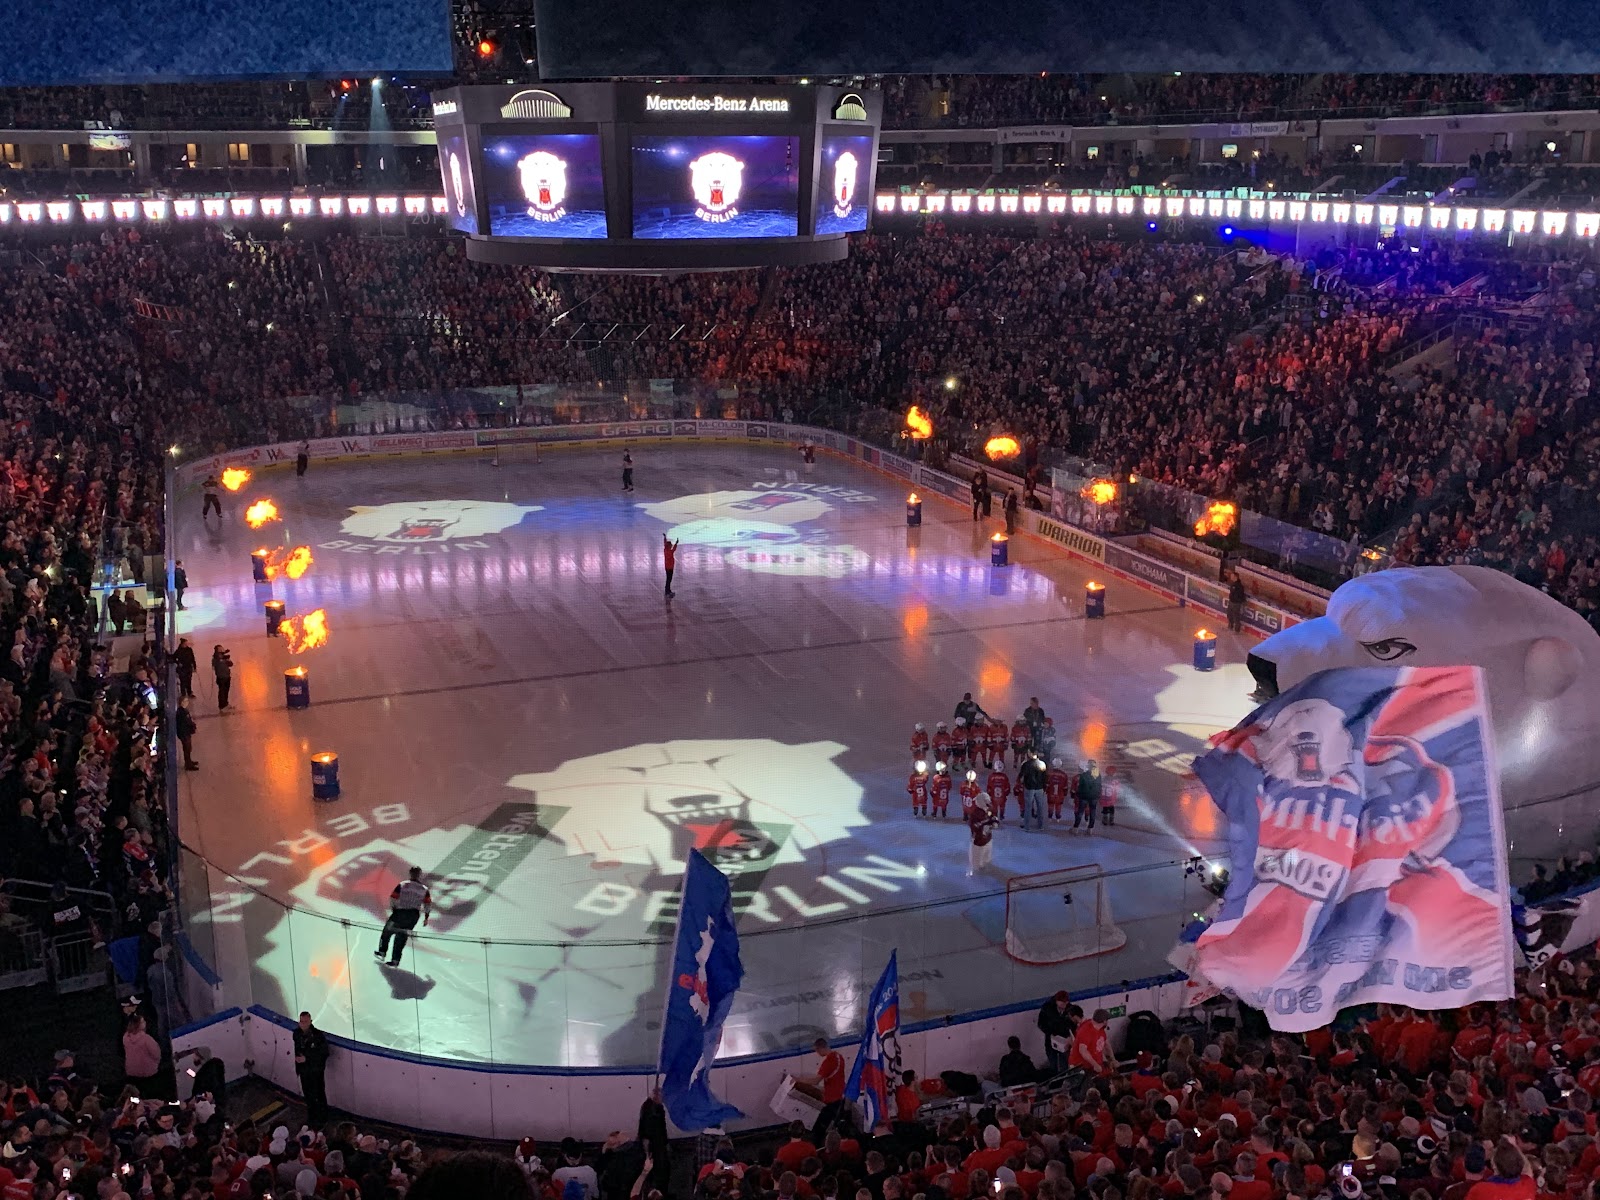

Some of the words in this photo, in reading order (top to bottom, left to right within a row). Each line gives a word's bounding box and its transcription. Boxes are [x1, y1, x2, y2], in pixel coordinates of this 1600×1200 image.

[646, 95, 747, 112] Mercedes-Benz
[749, 96, 789, 112] Arena
[527, 206, 566, 223] BERLIN
[694, 206, 738, 223] BERLIN
[602, 424, 672, 437] GASAG
[1039, 519, 1103, 557] WARRIOR
[318, 539, 491, 555] BERLIN
[1131, 560, 1168, 584] YOKOHAMA
[1222, 597, 1278, 629] GSAG
